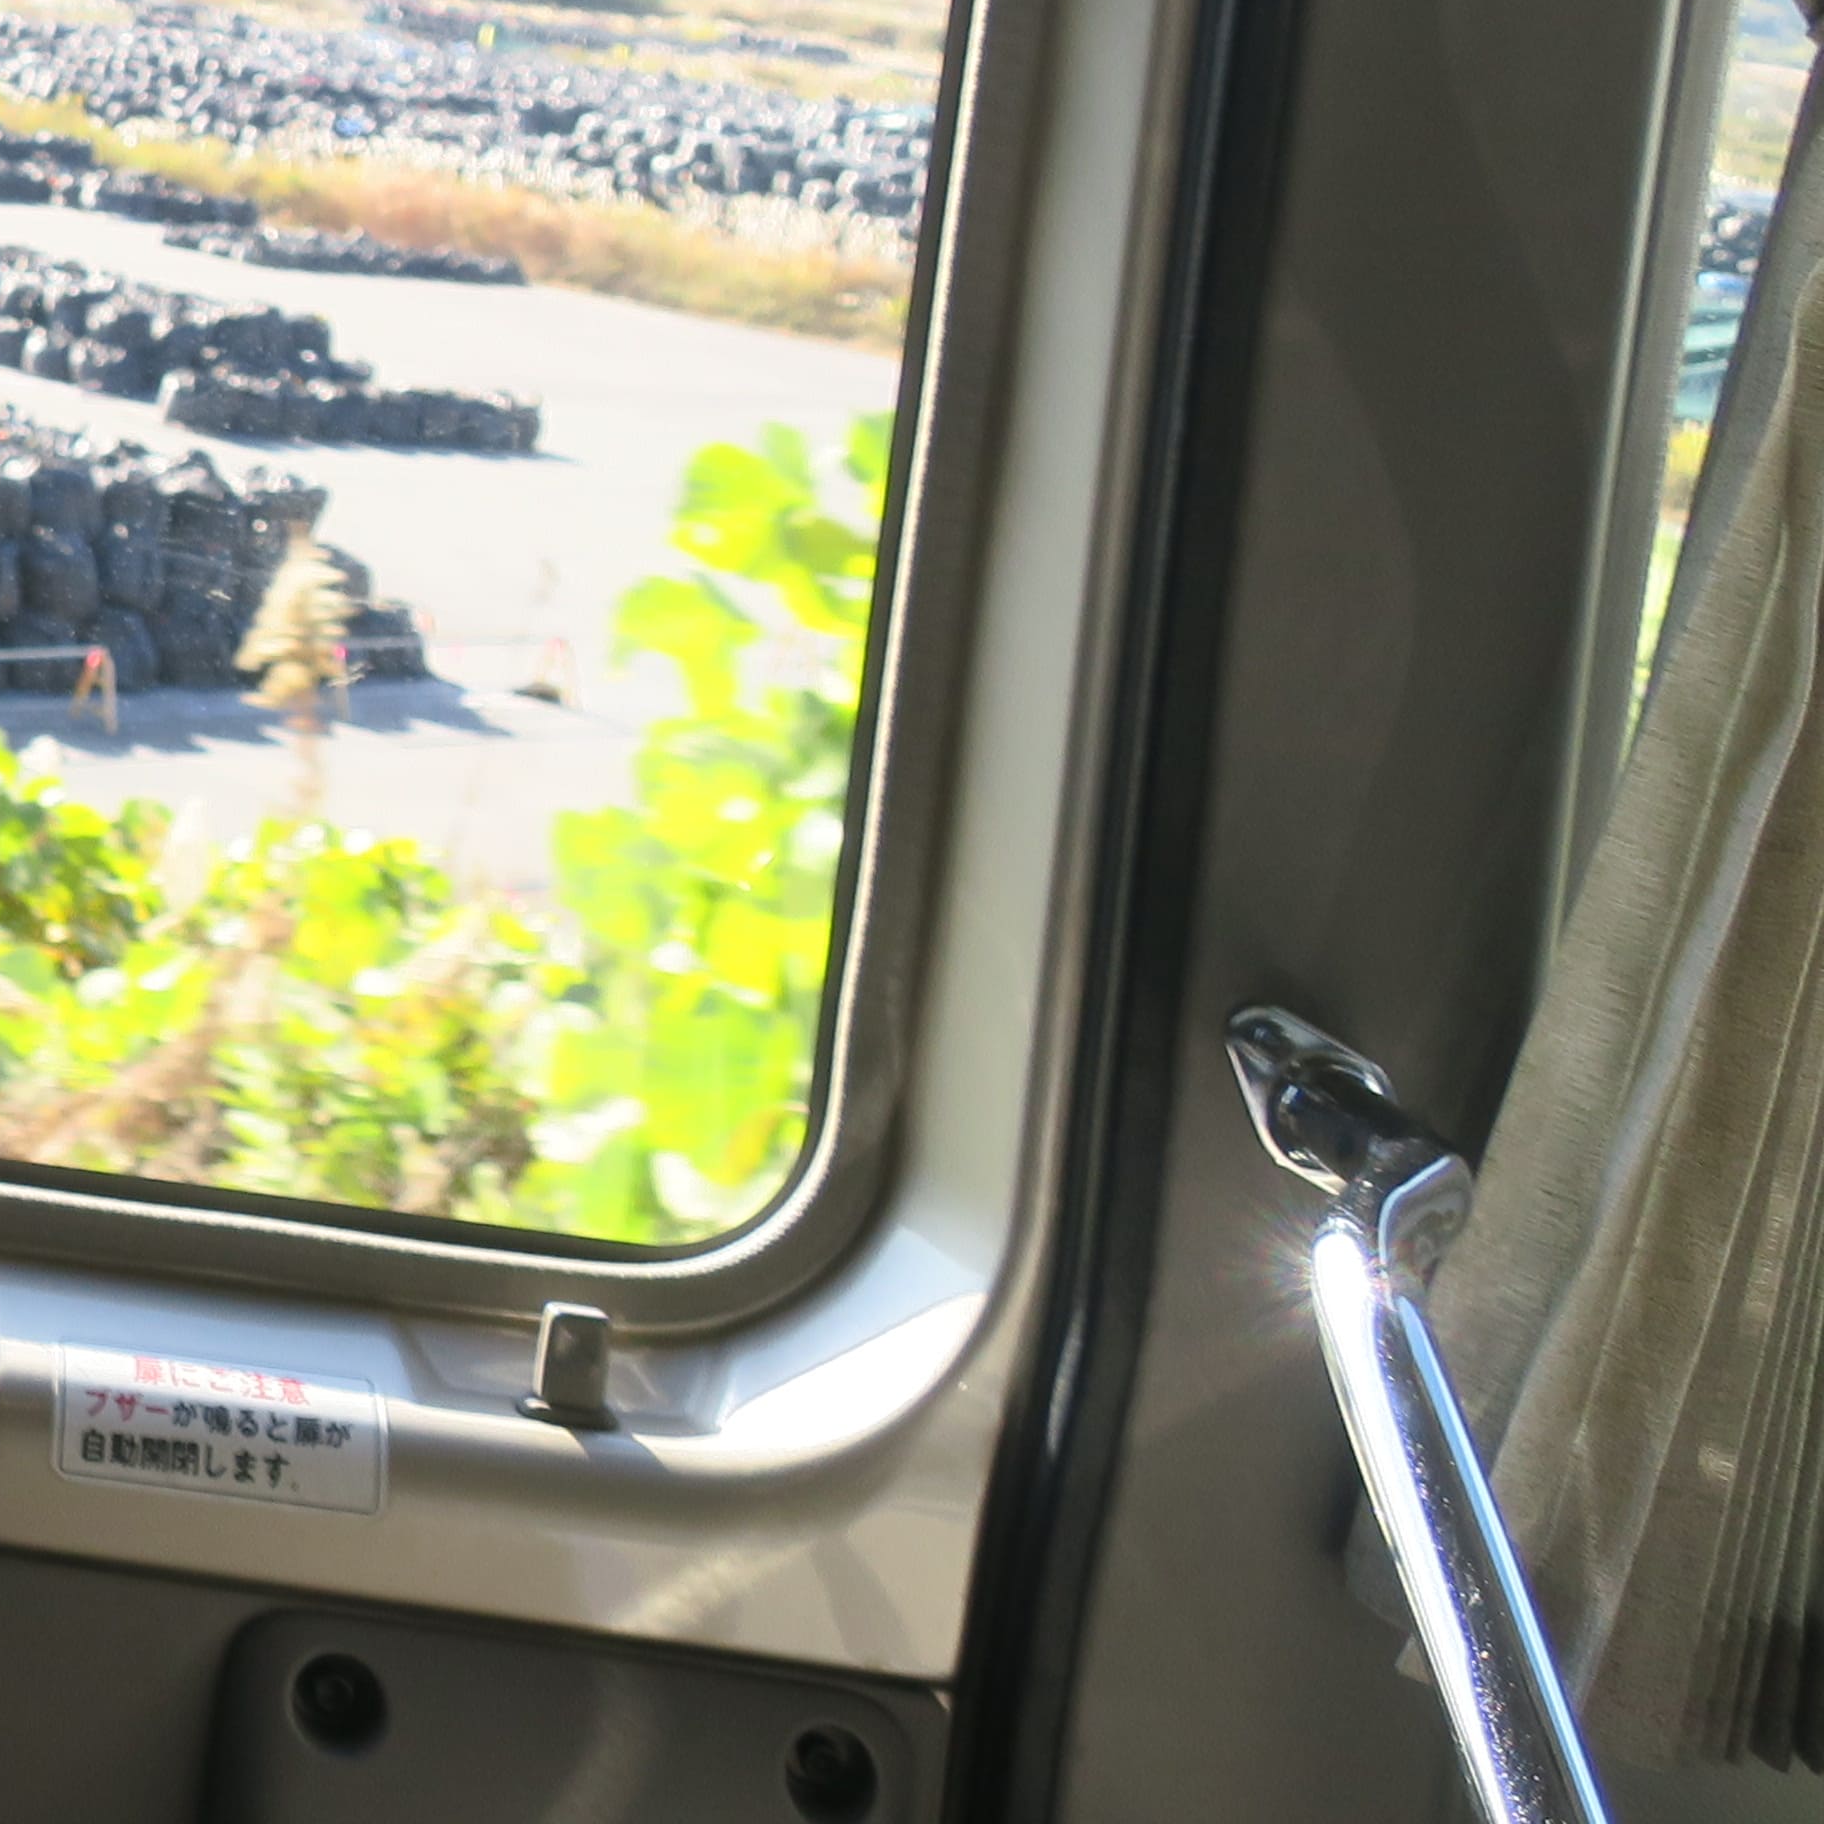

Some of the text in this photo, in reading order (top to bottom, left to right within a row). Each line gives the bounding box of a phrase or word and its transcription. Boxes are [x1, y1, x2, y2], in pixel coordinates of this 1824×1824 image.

[133, 1355, 311, 1405] 扉にご注意
